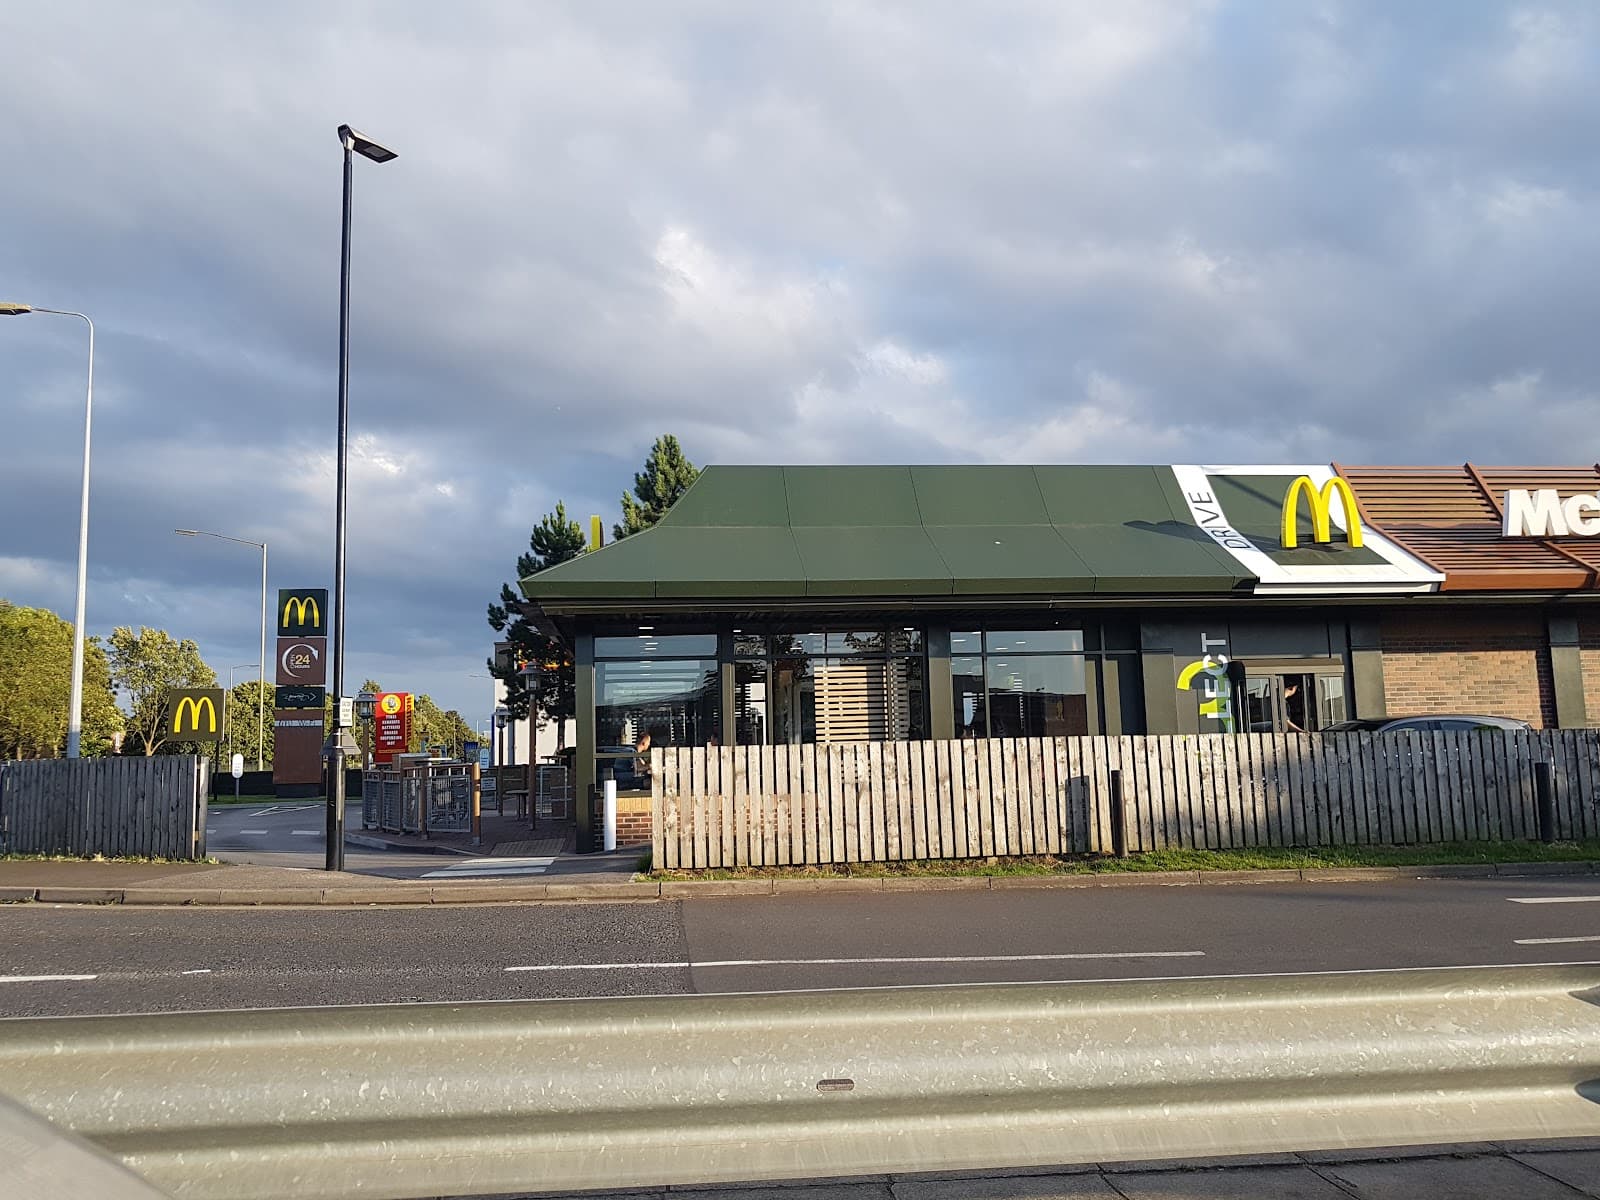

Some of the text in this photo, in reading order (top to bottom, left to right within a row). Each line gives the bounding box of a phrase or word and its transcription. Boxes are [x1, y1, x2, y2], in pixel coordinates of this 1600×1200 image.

[1188, 492, 1251, 550] DRIVE
[1502, 488, 1600, 537] Mc
[295, 654, 310, 665] 24
